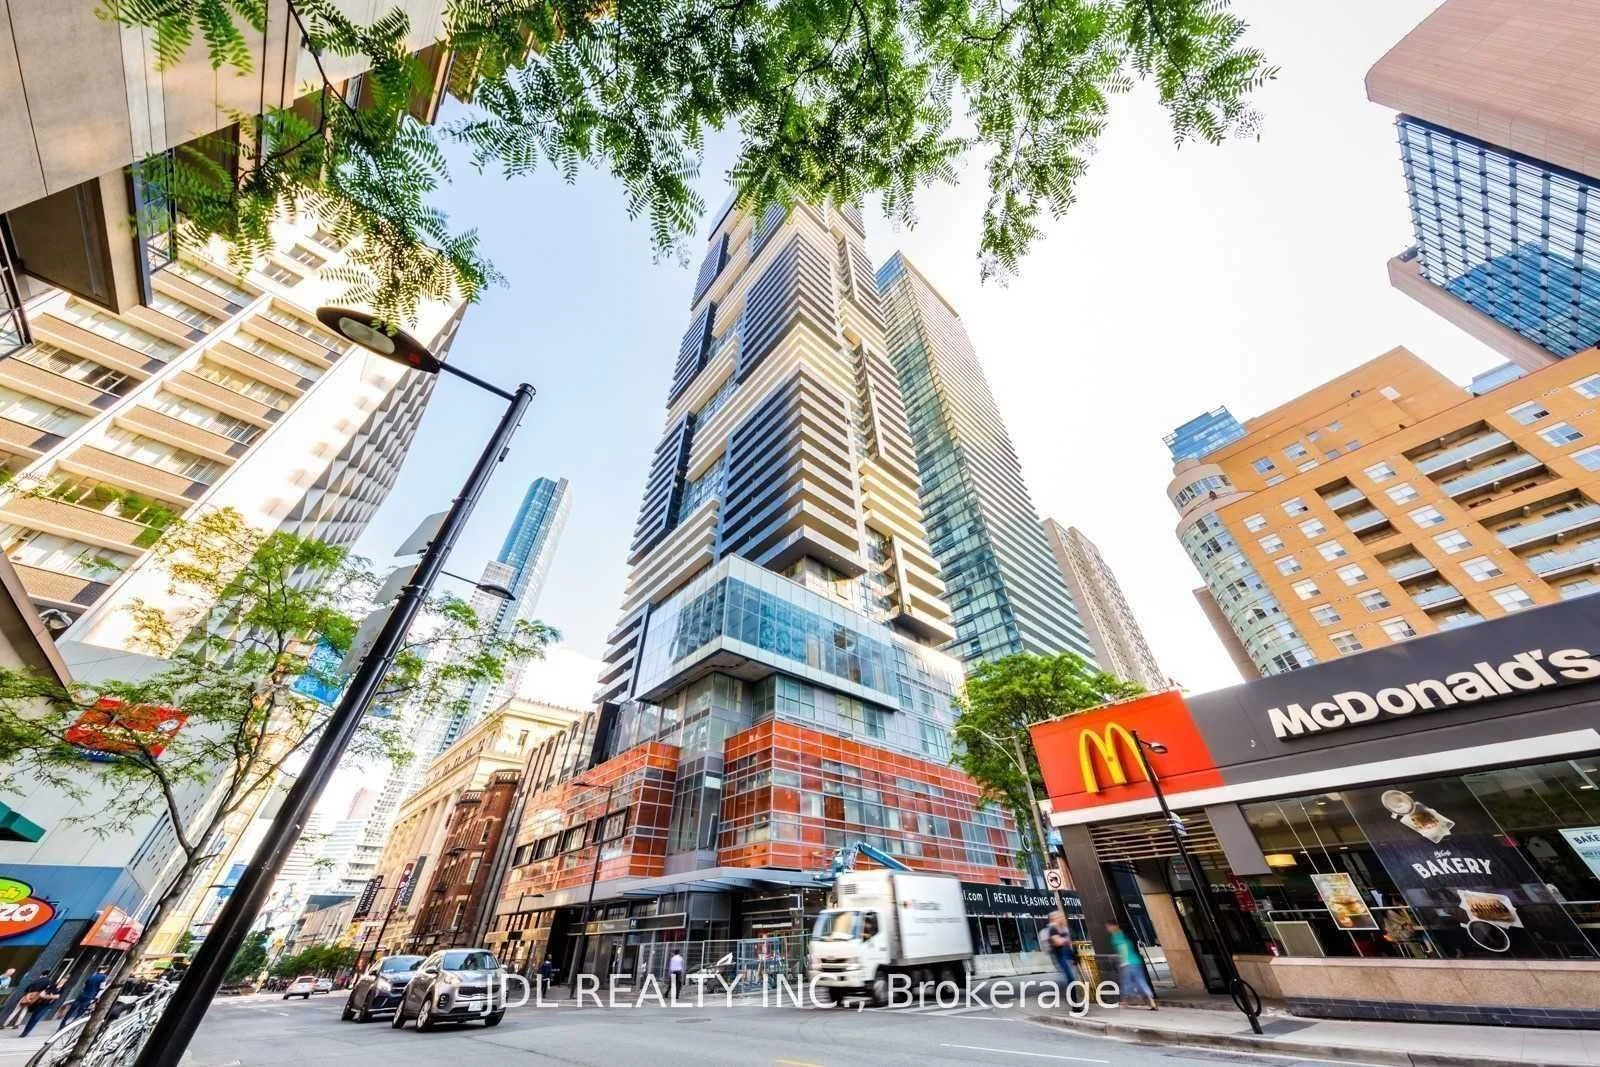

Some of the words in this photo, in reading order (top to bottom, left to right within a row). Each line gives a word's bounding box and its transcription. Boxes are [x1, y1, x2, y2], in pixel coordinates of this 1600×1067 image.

[1267, 649, 1600, 739] McDonald's
[1411, 857, 1492, 879] BAKERY
[993, 892, 1019, 905] RETAIL
[1020, 894, 1050, 907] LEASING
